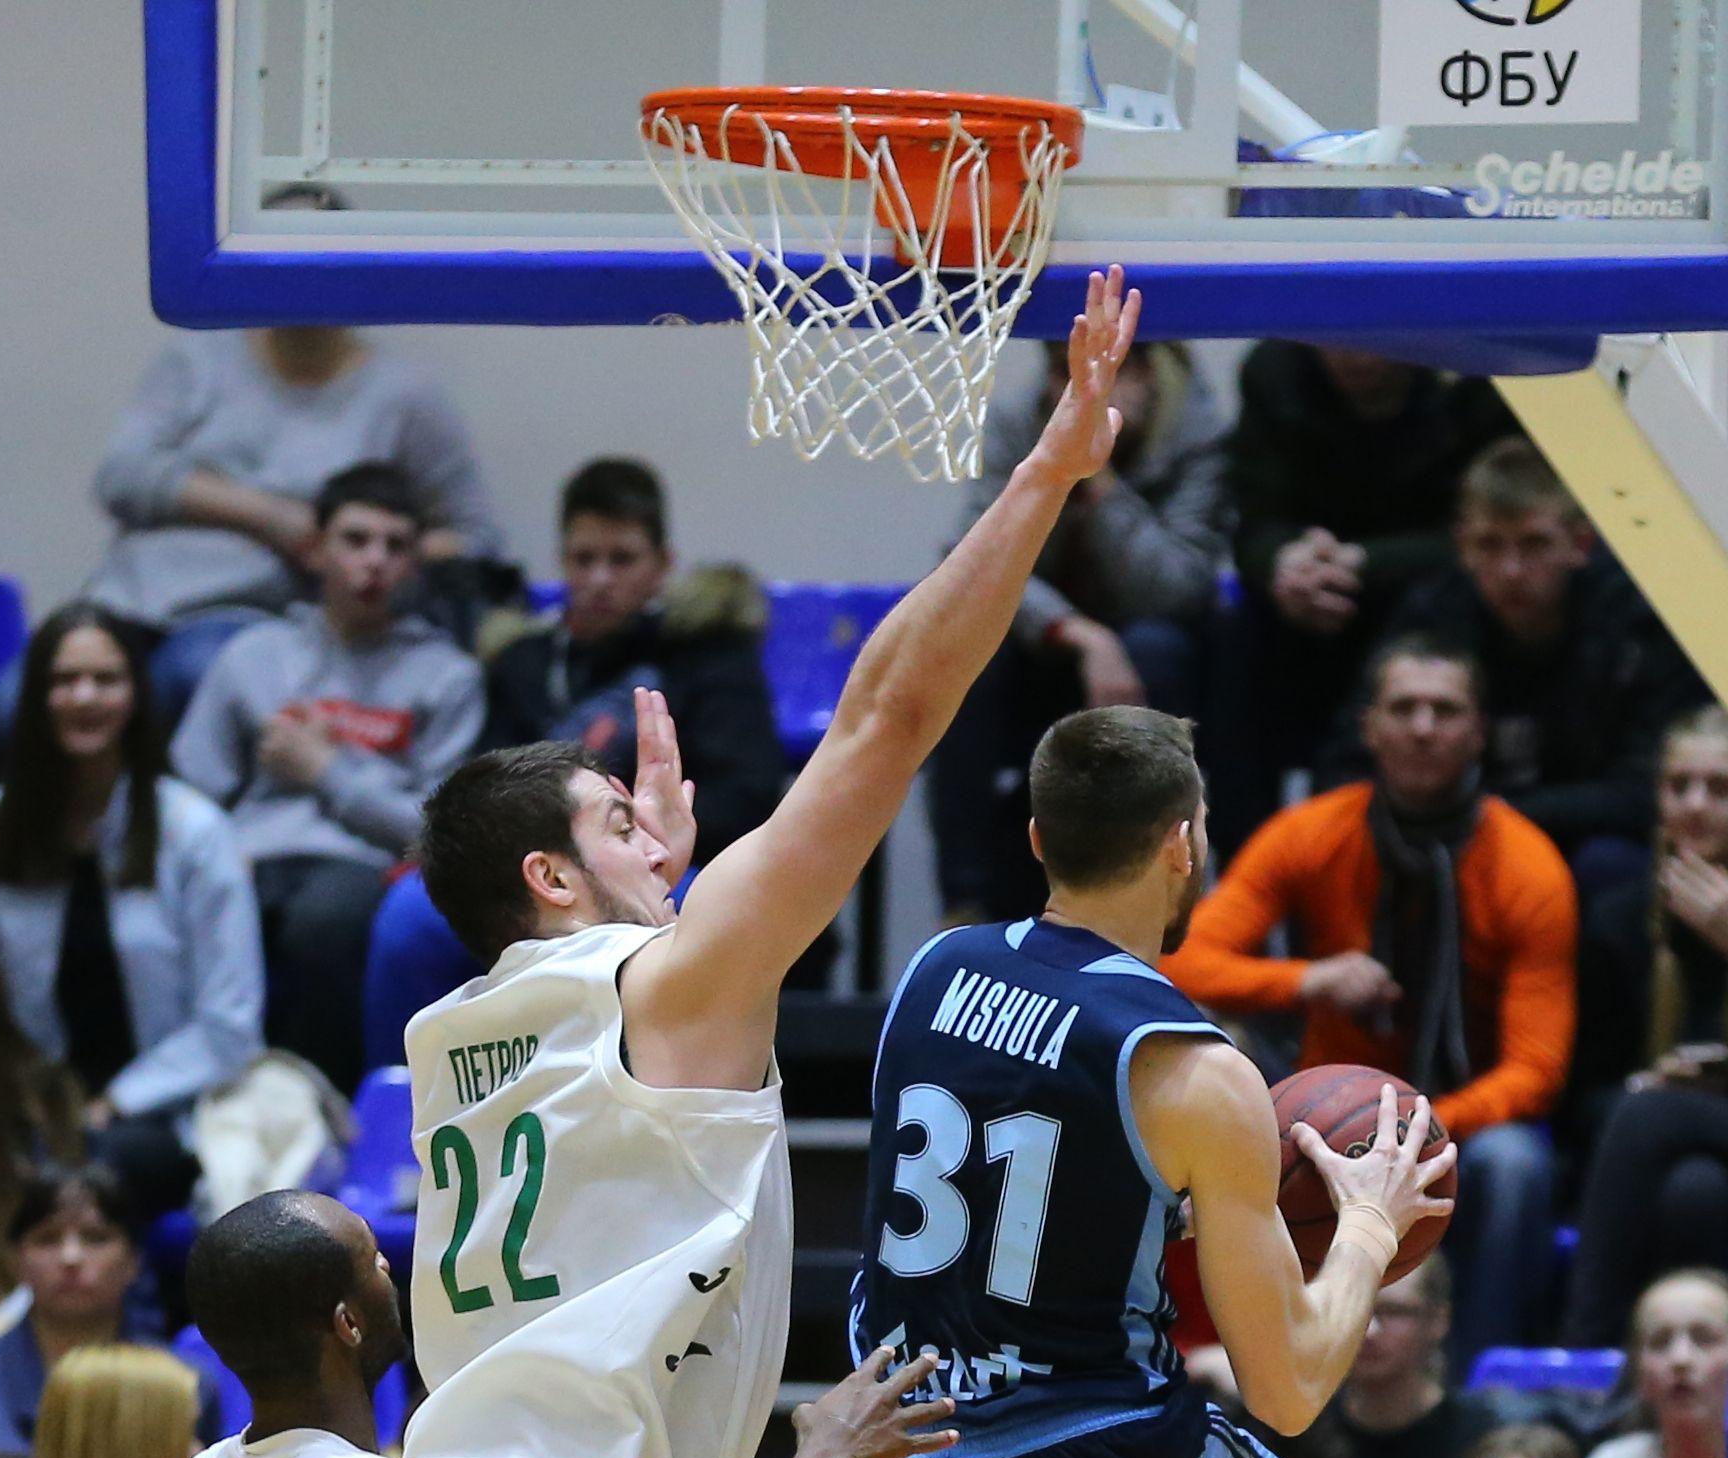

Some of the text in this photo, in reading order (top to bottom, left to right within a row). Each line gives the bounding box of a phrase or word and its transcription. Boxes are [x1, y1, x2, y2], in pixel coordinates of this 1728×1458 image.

[1439, 49, 1579, 107] ФБУ
[1464, 150, 1705, 217] Schelde
[929, 966, 1081, 1070] MISHULA
[430, 1110, 561, 1314] 22
[877, 1083, 1062, 1307] 31
